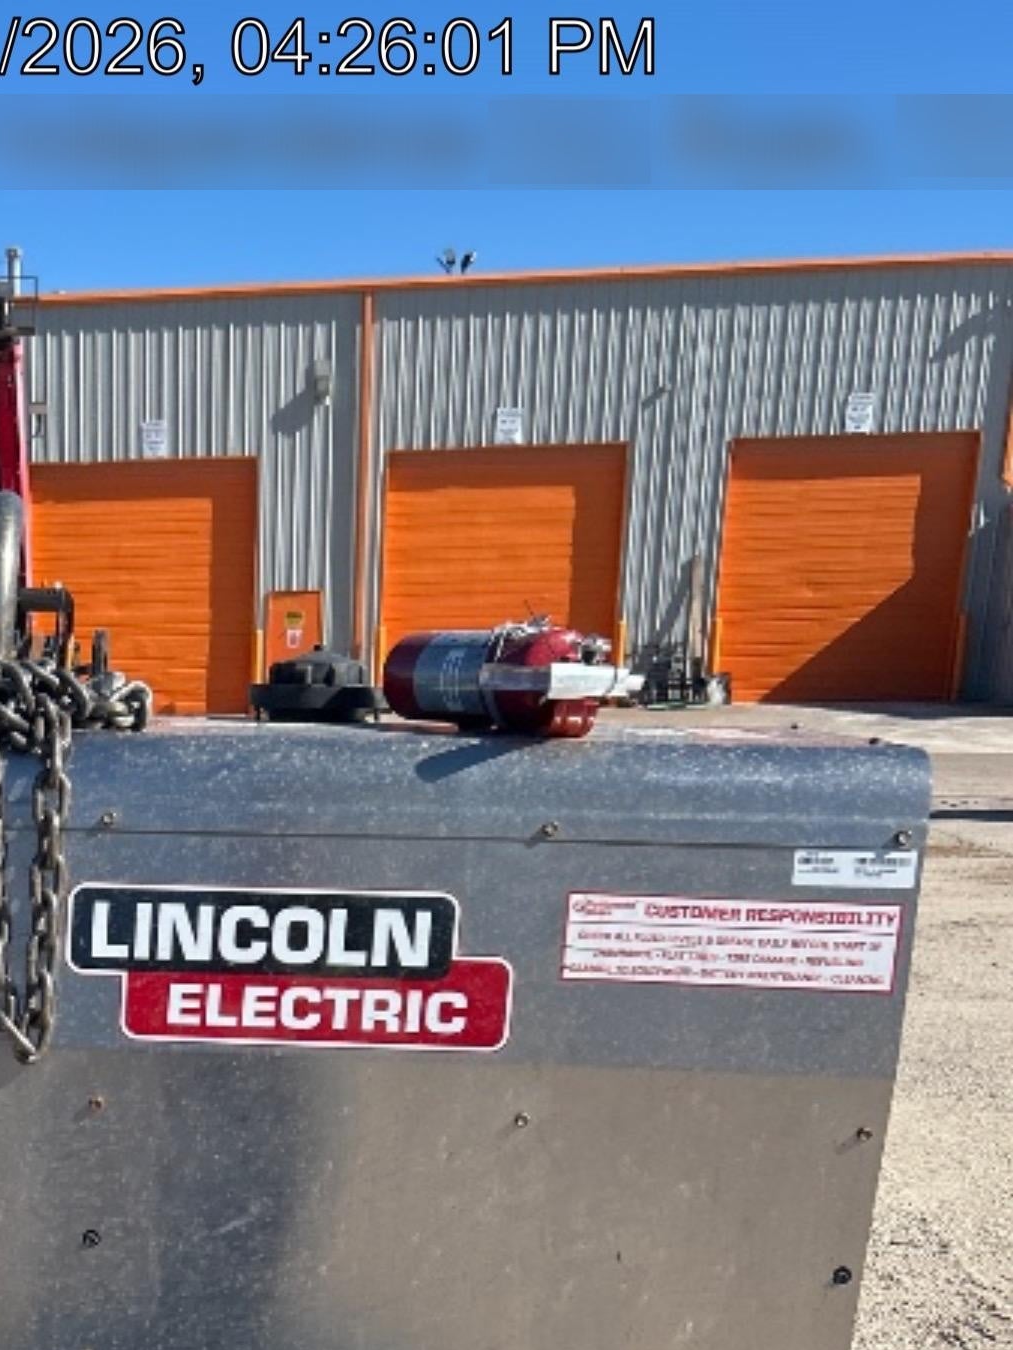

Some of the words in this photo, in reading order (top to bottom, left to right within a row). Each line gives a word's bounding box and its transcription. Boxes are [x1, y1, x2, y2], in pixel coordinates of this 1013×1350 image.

[90, 902, 433, 967] LINCOLN
[645, 903, 741, 922] CUSTOMER
[745, 907, 897, 927] RESPONSIBILITY
[166, 983, 468, 1034] ELECTRIC
